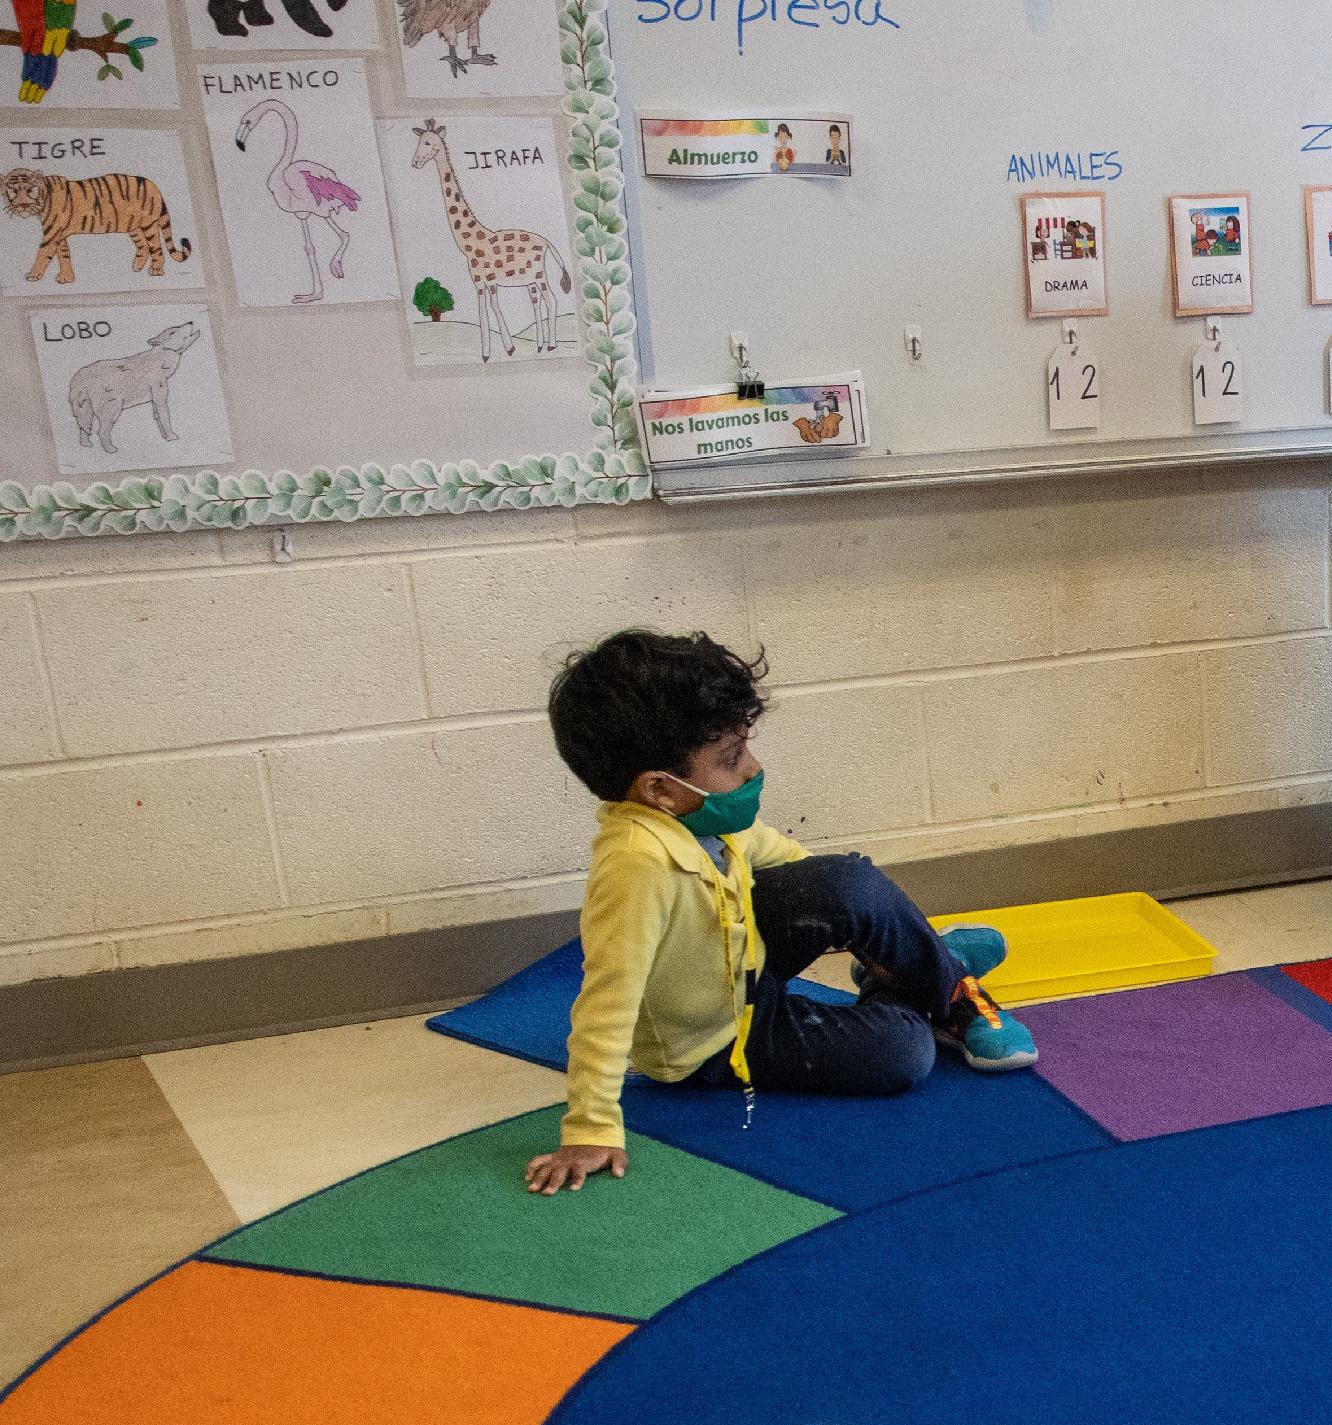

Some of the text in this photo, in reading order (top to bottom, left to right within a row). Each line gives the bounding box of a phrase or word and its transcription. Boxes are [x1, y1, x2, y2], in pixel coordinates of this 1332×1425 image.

[202, 70, 340, 95] FLAMENCO
[10, 138, 106, 160] TIGRE
[464, 147, 544, 170] JIRAFA
[667, 148, 759, 166] Almuerzo
[1007, 150, 1123, 183] ANIMALES
[1044, 279, 1088, 293] DRAMA
[1191, 273, 1242, 288] CIENCIA
[43, 320, 112, 342] LOBO
[651, 408, 789, 437] Nos lavamos las
[697, 436, 753, 455] manos
